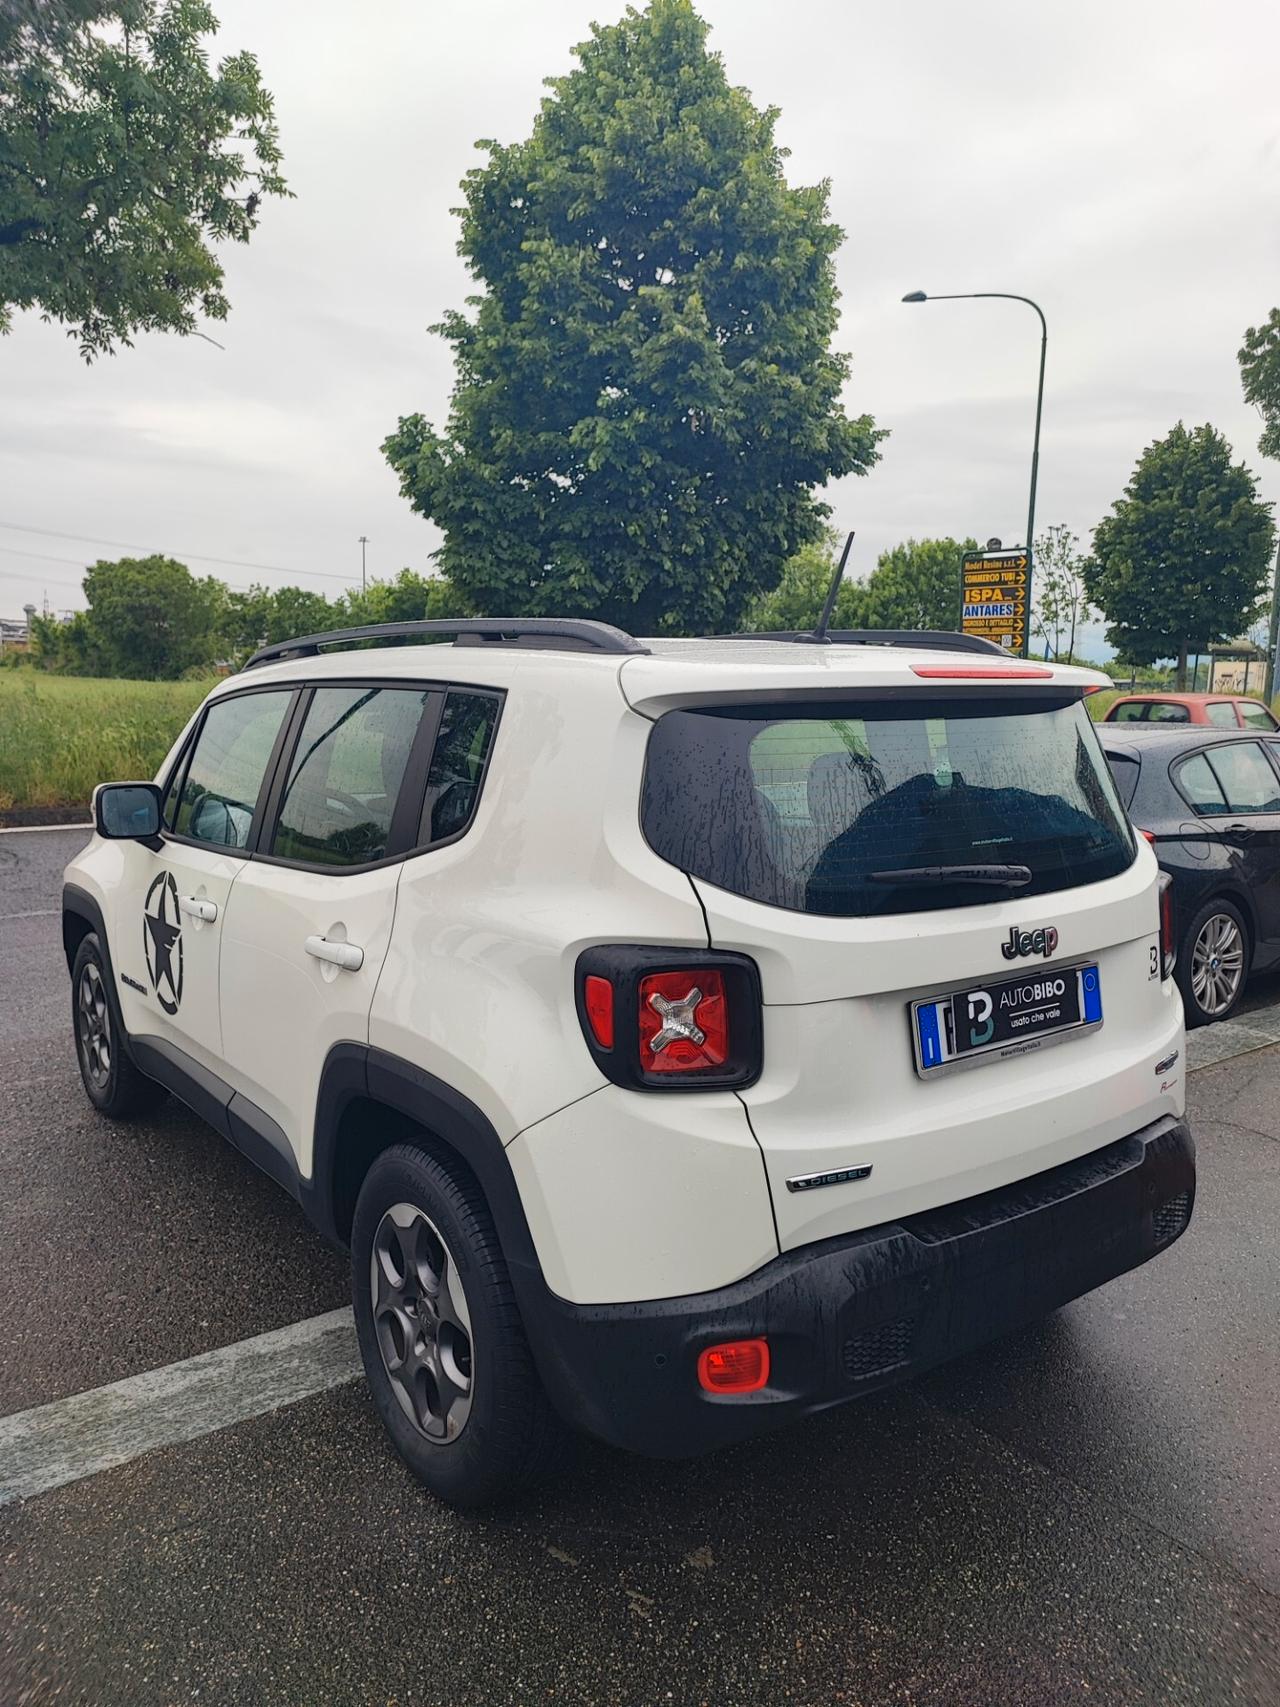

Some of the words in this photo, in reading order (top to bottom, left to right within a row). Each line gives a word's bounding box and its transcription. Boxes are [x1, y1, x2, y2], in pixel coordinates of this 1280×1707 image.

[965, 573, 1000, 584] COMMERCIO
[1001, 572, 1015, 582] TUBI
[965, 589, 1003, 602] ISPA
[964, 604, 1012, 617] ANTARES
[1001, 926, 1059, 960] Jeep
[1000, 979, 1066, 1009] AUTOBIBO
[1011, 1016, 1030, 1028] usato
[1031, 1012, 1045, 1023] che
[1045, 1009, 1061, 1019] vale
[810, 1170, 867, 1186] DIESEL
